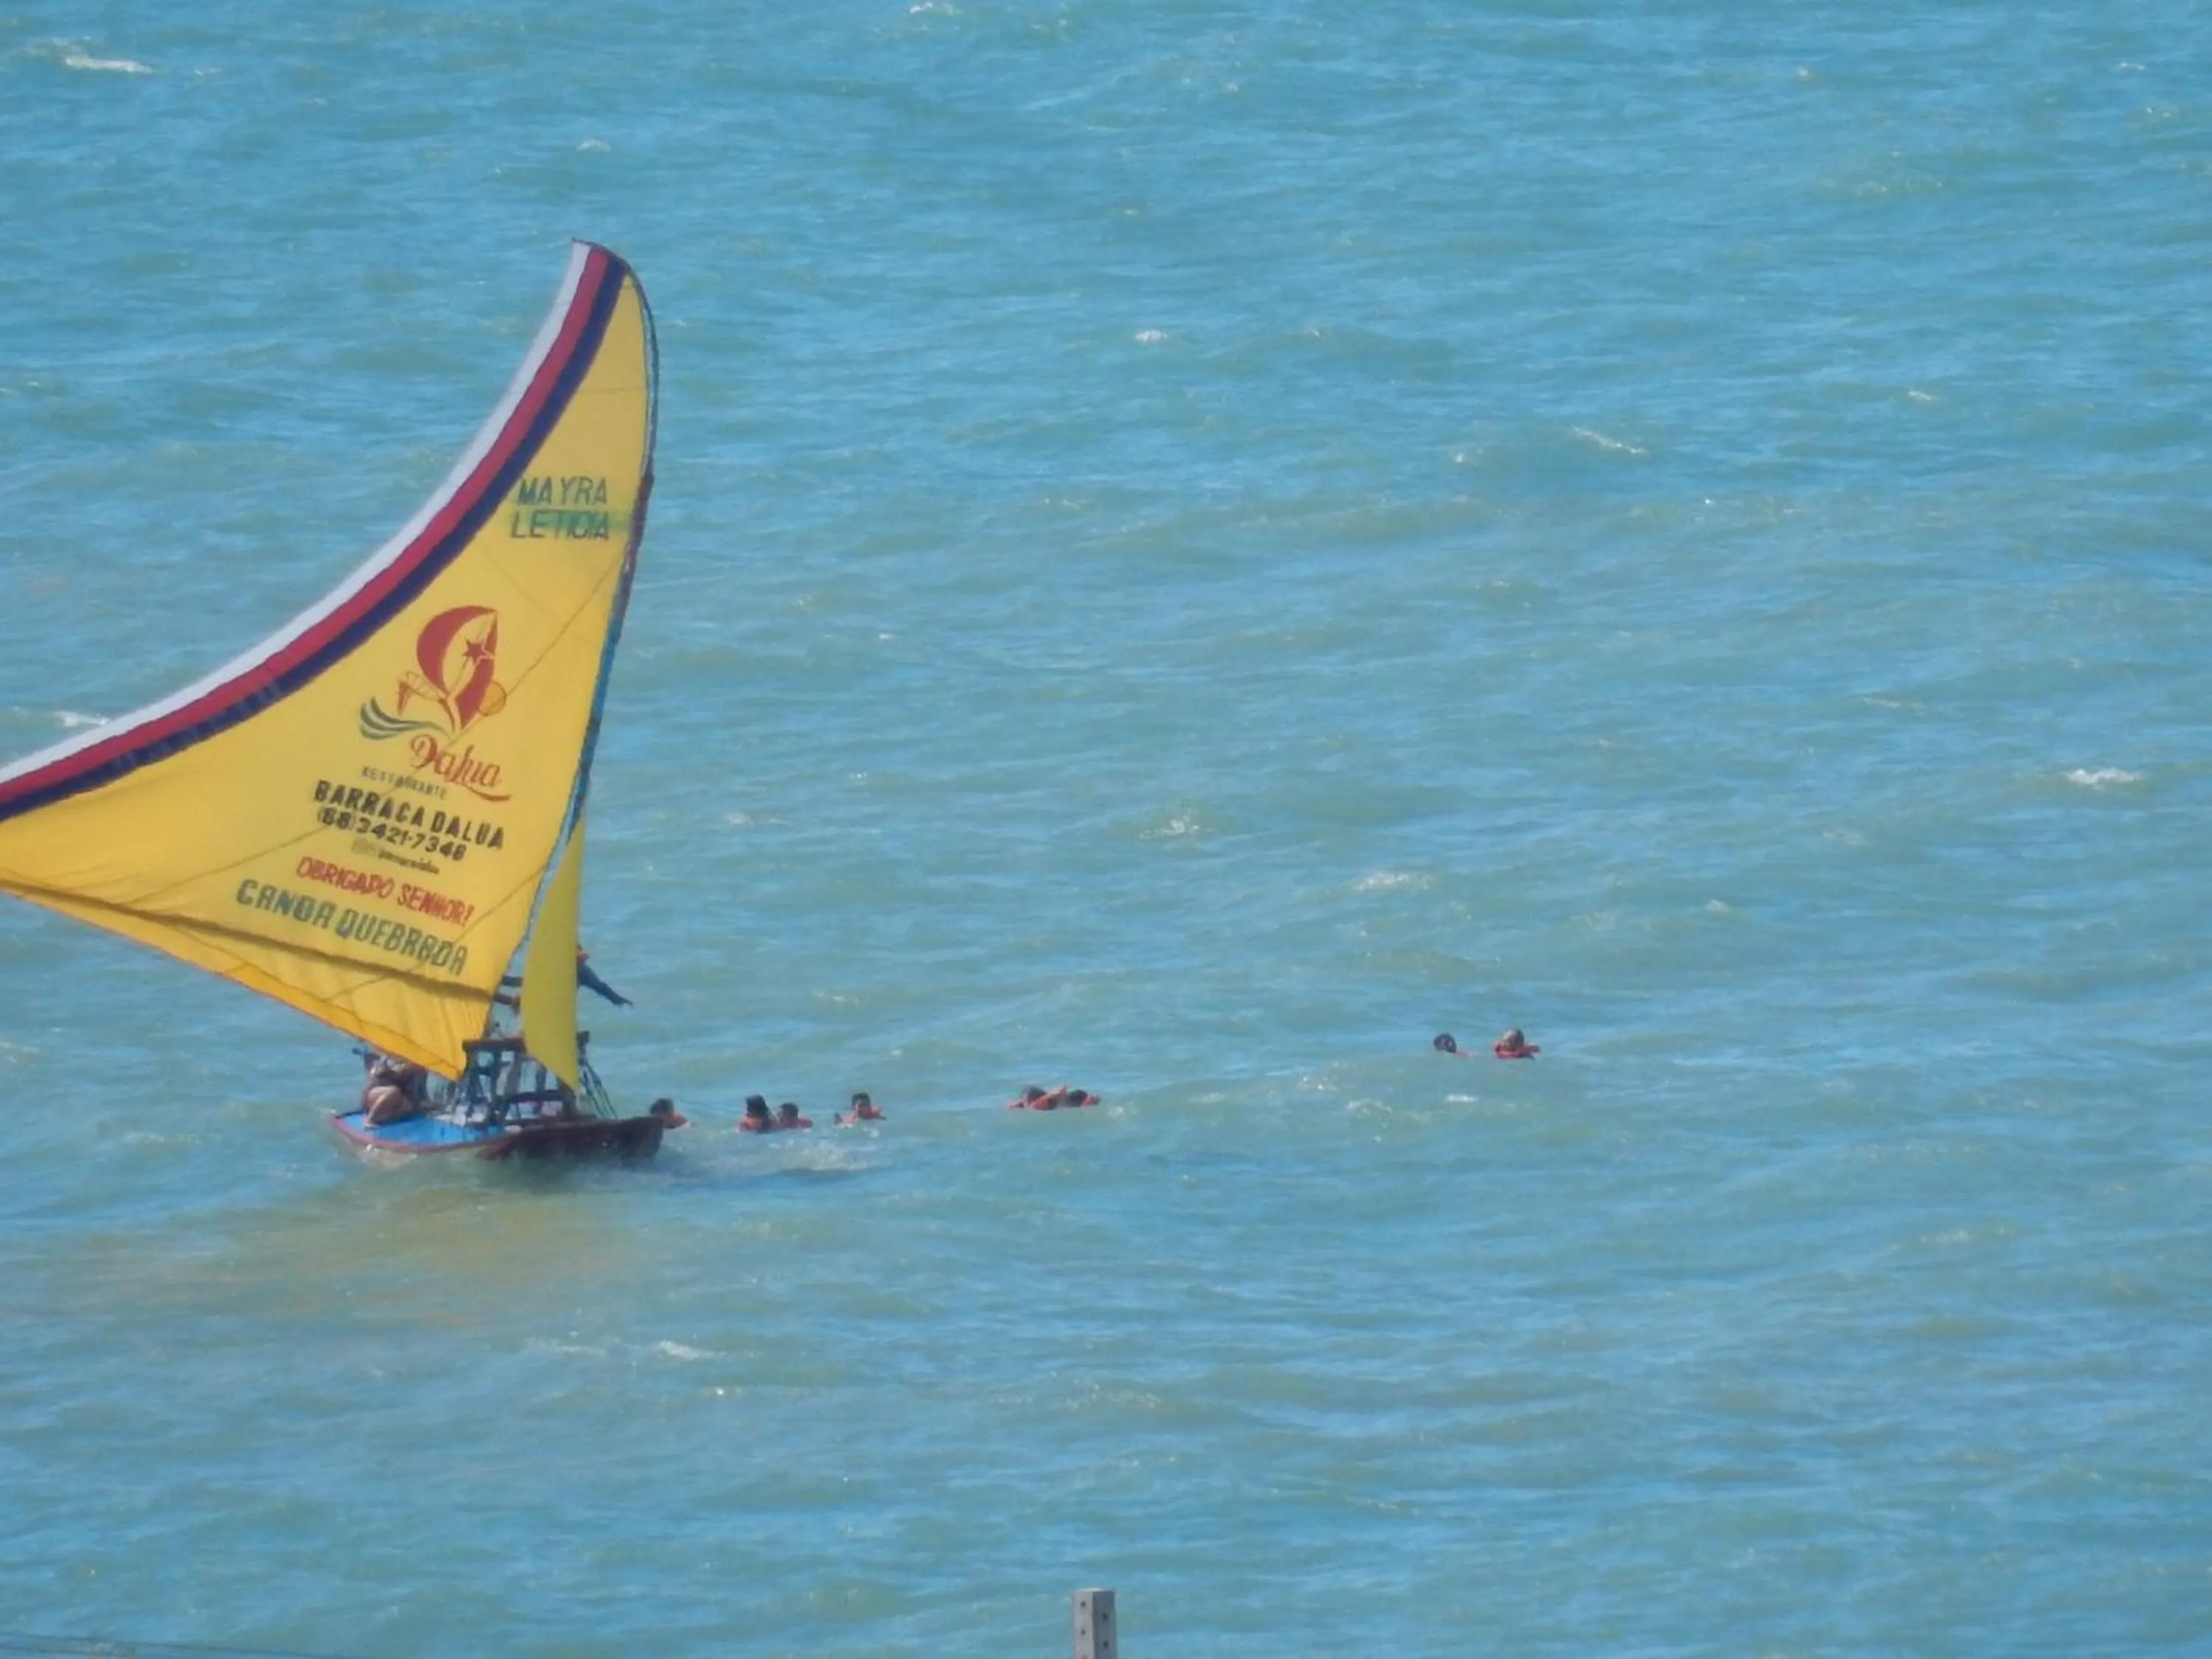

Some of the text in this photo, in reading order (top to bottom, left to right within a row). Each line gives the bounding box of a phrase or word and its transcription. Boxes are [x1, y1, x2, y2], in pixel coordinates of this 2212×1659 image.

[518, 474, 607, 506] MAYRA
[314, 779, 504, 849] BARRACA DALUA
[296, 856, 395, 899] OBRIGADO
[236, 879, 468, 975] CANOA QUEBRADA
